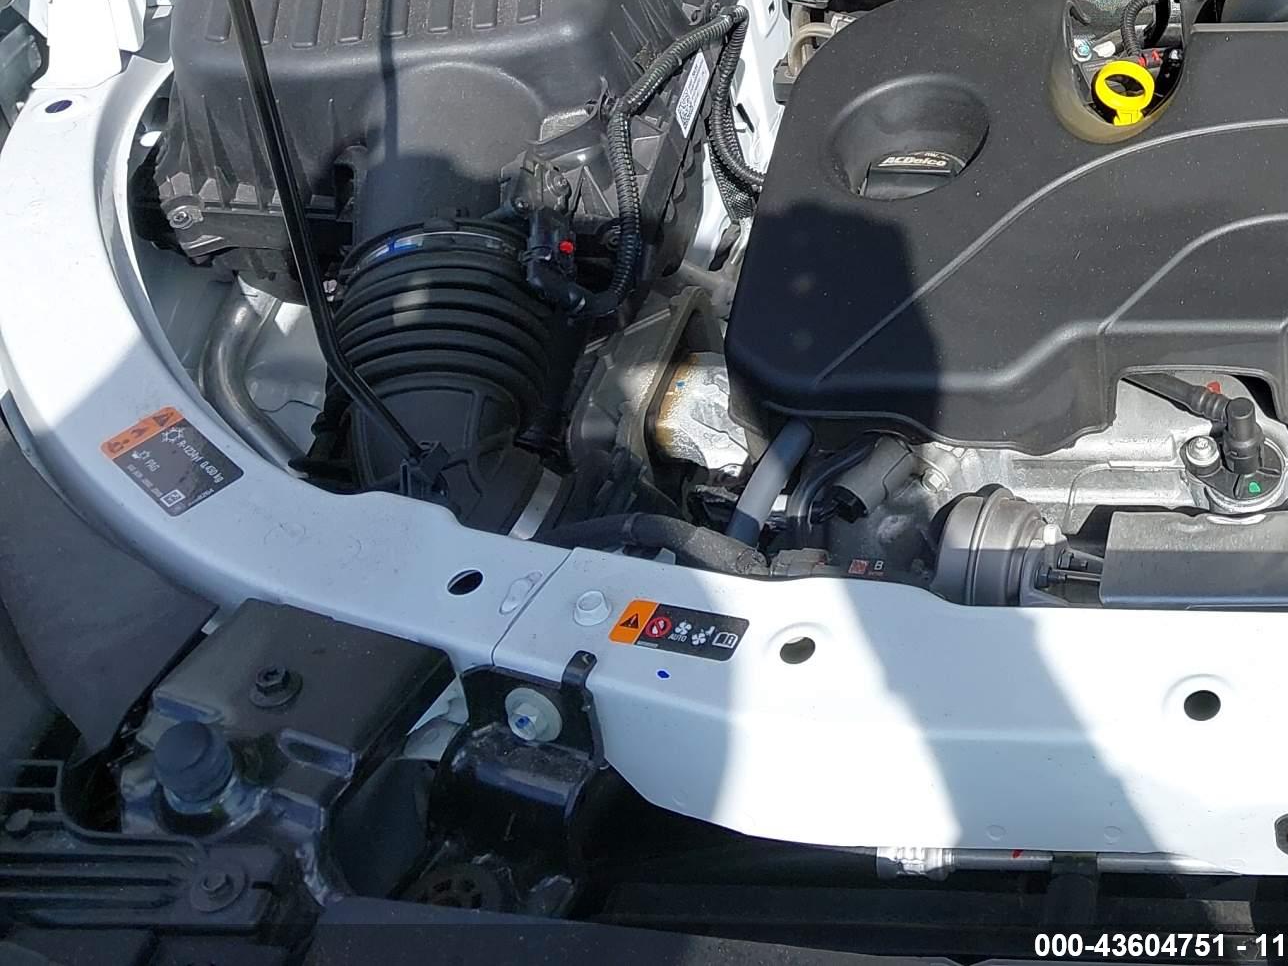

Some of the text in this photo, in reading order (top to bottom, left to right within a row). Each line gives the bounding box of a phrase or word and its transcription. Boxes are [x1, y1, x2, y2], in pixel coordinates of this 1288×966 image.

[882, 156, 948, 167] ACDelco
[873, 560, 884, 571] B
[667, 633, 688, 643] AUTO
